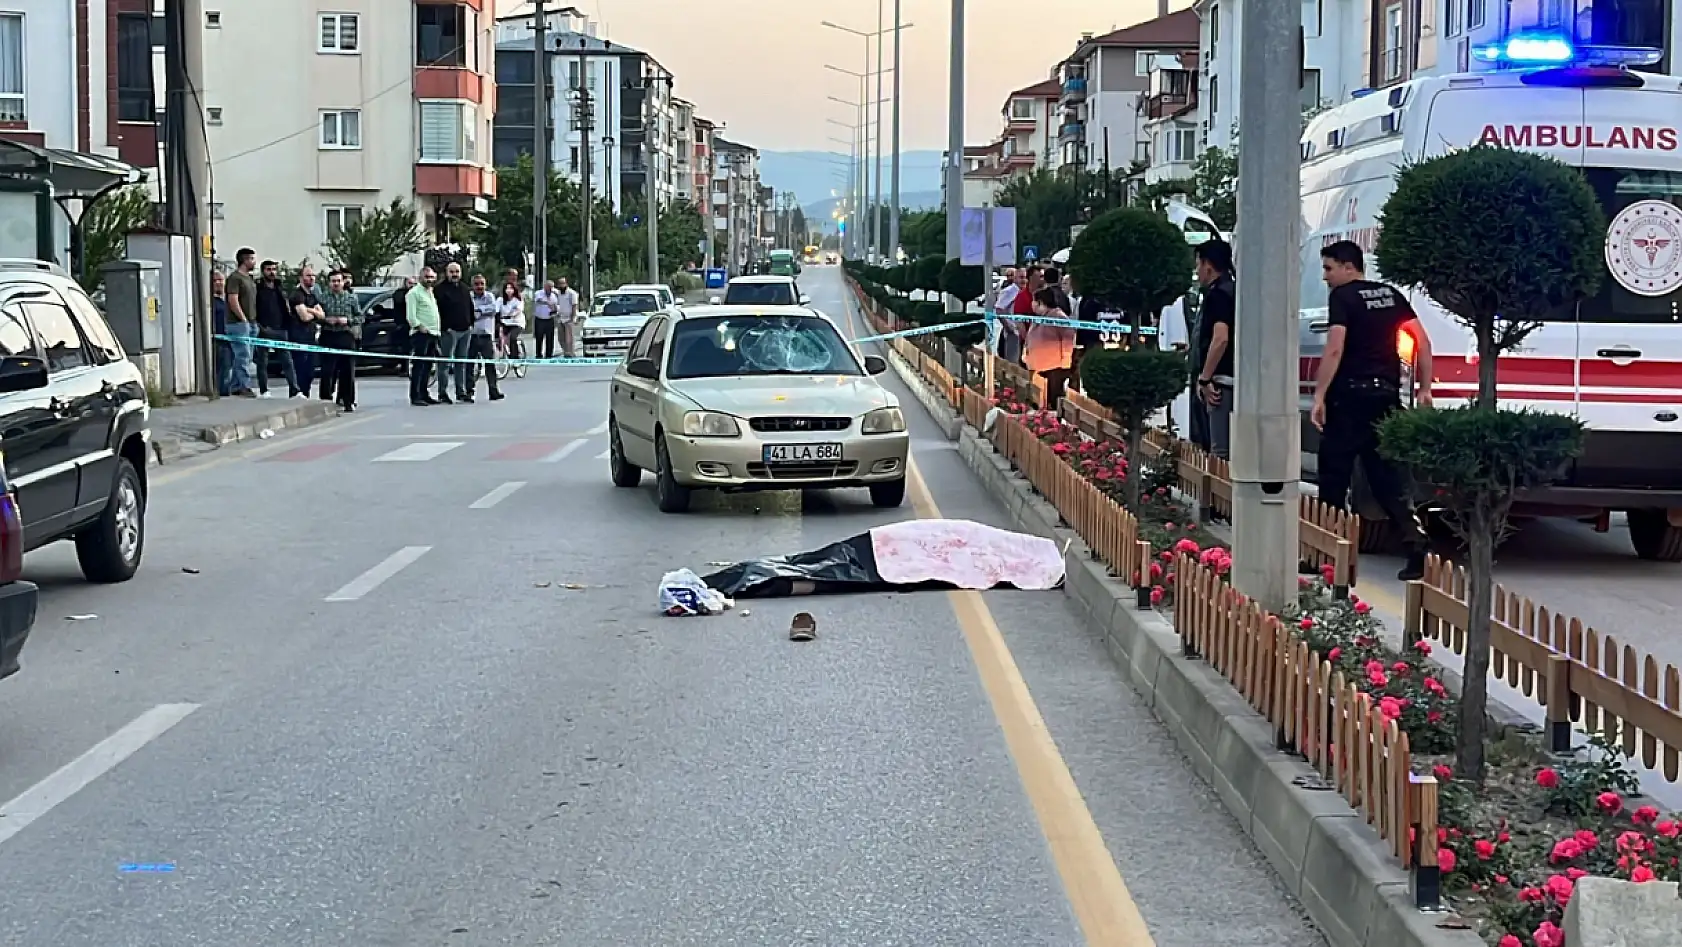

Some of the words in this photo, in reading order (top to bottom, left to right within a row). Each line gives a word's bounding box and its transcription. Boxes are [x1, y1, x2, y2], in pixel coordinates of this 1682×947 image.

[1479, 125, 1678, 150] AMBULANS
[772, 446, 787, 458] 41
[793, 446, 812, 459] LA
[817, 445, 840, 458] 684
